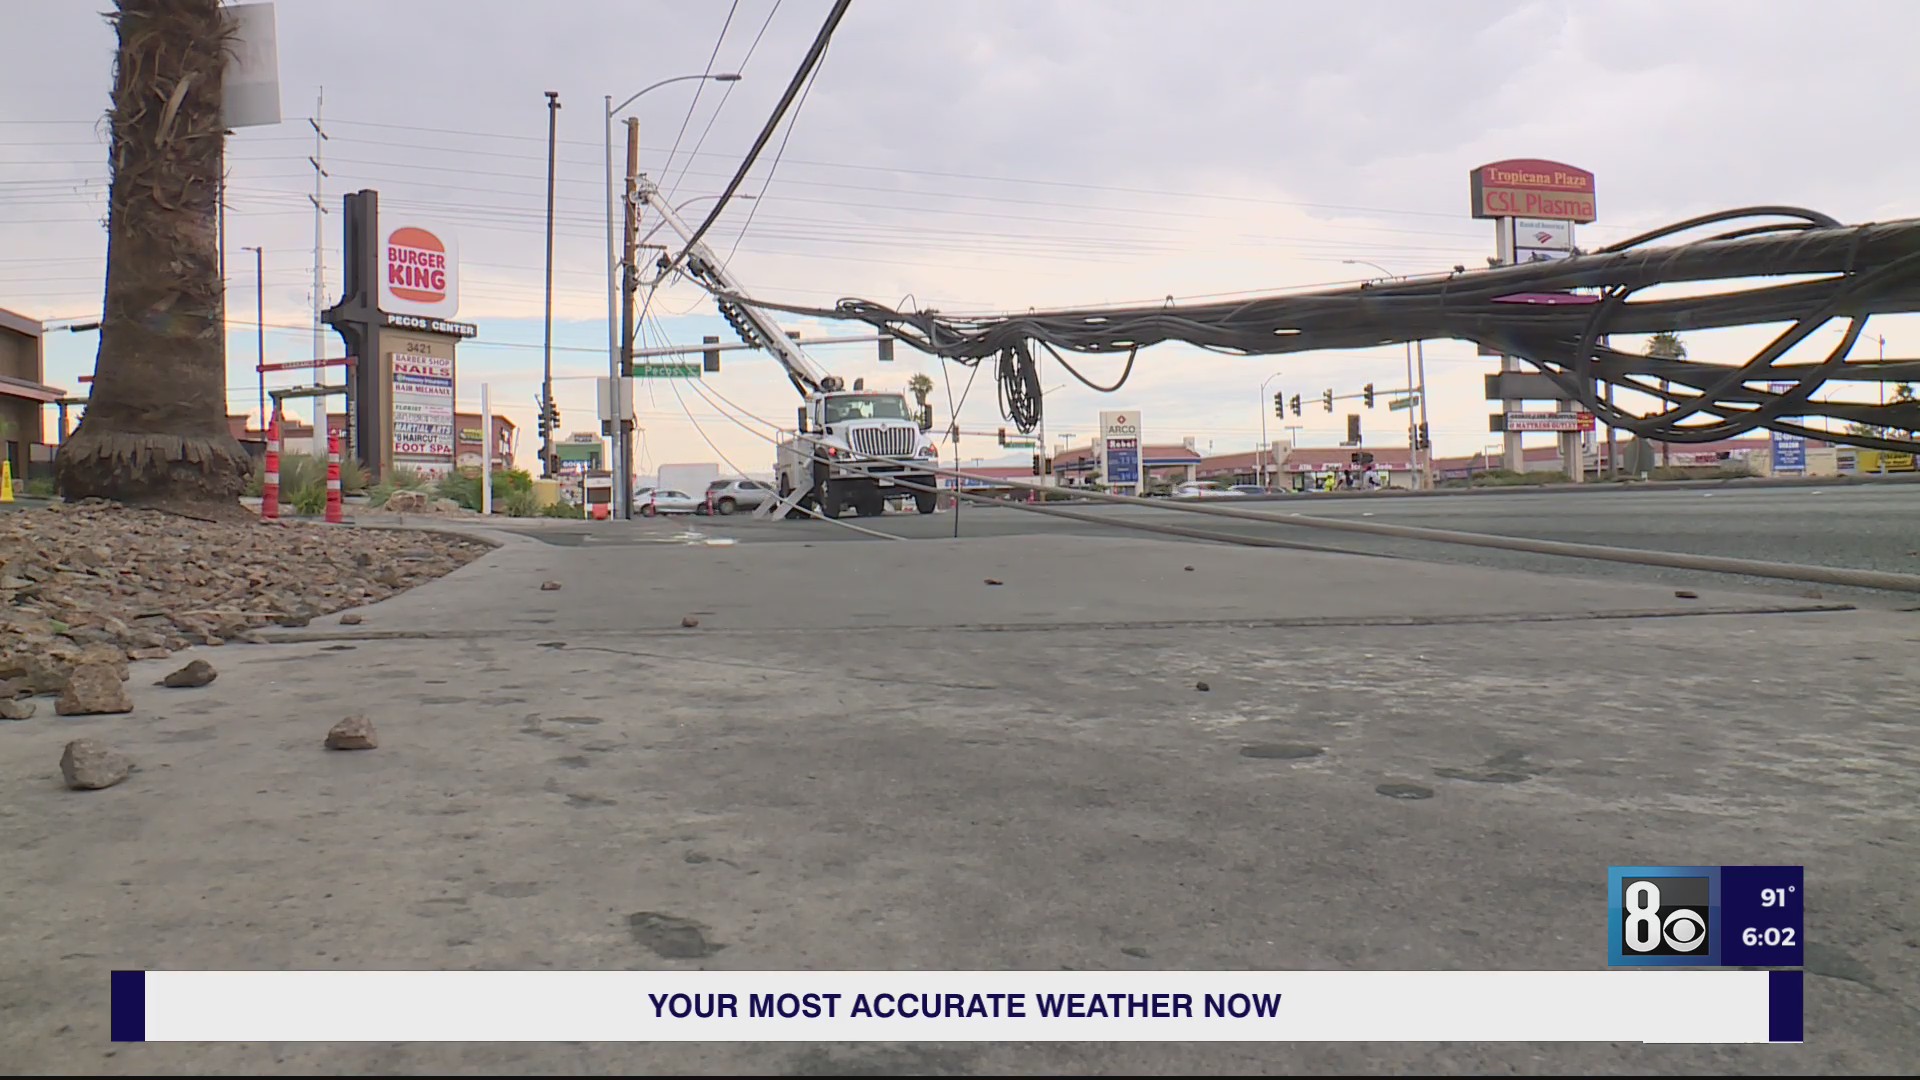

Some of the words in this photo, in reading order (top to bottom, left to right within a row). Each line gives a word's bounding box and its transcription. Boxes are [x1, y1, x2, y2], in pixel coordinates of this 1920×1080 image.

[1487, 167, 1551, 185] Tropicana
[1554, 172, 1587, 186] Plaza
[1486, 191, 1520, 213] CSL
[1526, 193, 1593, 216] Plasma
[1541, 222, 1565, 230] America
[388, 247, 446, 269] BURGER
[388, 263, 446, 290] KING
[388, 315, 427, 328] PECOS
[431, 321, 475, 334] CENTER
[407, 342, 432, 354] 3421
[395, 354, 426, 364] BARBER
[429, 358, 450, 366] SHOP
[395, 364, 450, 376] NAILS
[644, 365, 680, 377] Pecos
[395, 422, 428, 432] MARTIAL
[430, 424, 452, 435] ARTS
[1109, 425, 1136, 433] ARCO
[402, 434, 438, 442] HAIRCUT
[1110, 440, 1135, 448] Rebel
[395, 442, 425, 452] FOOT
[429, 444, 451, 453] SPA
